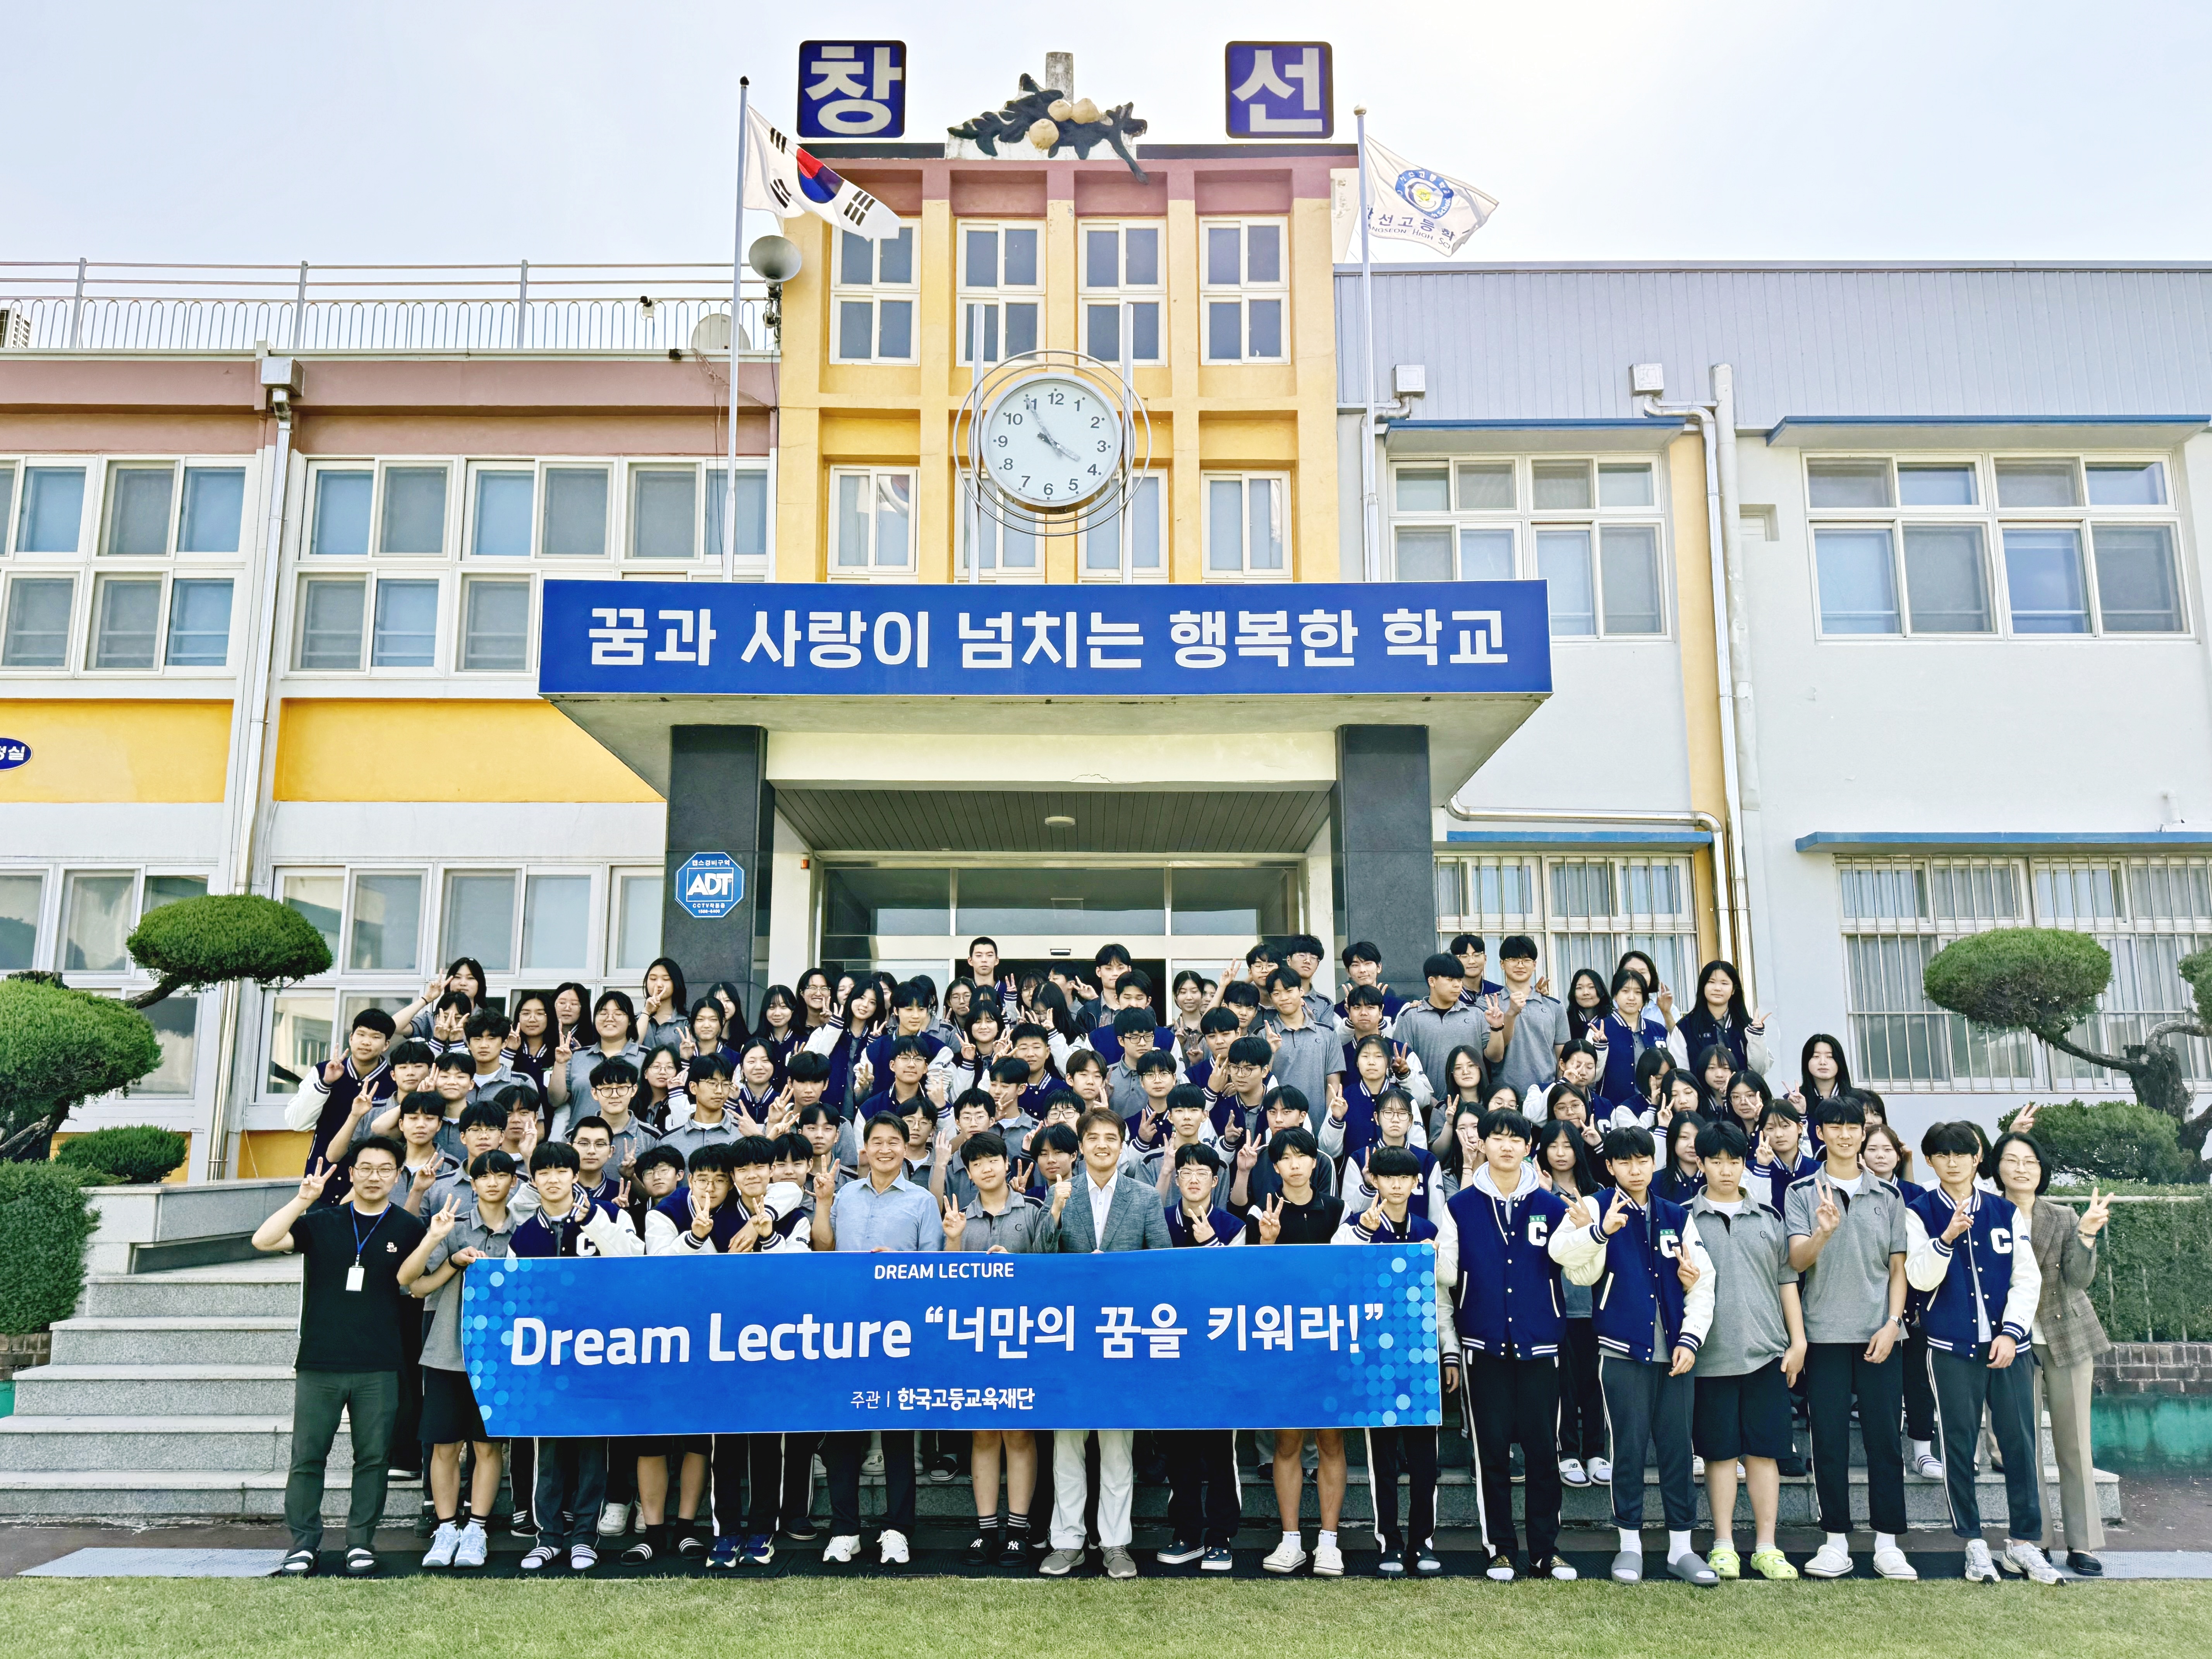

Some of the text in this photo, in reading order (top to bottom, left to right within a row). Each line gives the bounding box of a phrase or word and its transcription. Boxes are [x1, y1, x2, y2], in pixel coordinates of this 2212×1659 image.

[805, 46, 902, 134] 창
[1232, 48, 1323, 132] 선
[1048, 392, 1064, 405] 12
[1075, 400, 1081, 411] 1
[1006, 413, 1022, 425] 10
[1091, 417, 1100, 428] 2
[998, 435, 1008, 447] 9
[1097, 440, 1107, 452] 3
[1003, 458, 1013, 470] 8
[1087, 464, 1097, 476] 4
[1021, 476, 1030, 488] 7
[1068, 479, 1079, 491] 5
[1044, 483, 1053, 495] 6
[589, 608, 1508, 668] 꿈과 사랑이 넘치는 행복한 학교
[687, 873, 733, 895] ADT
[1528, 1222, 1547, 1246] C
[576, 1232, 596, 1256] C
[1990, 1228, 2012, 1254] C
[874, 1262, 1014, 1279] DREAM LECTURE
[510, 1303, 1384, 1365] Dream Lecture “너만의 꿈을 키워라!”
[850, 1391, 881, 1409] 주관
[897, 1387, 1035, 1411] 한국고등교육재단
